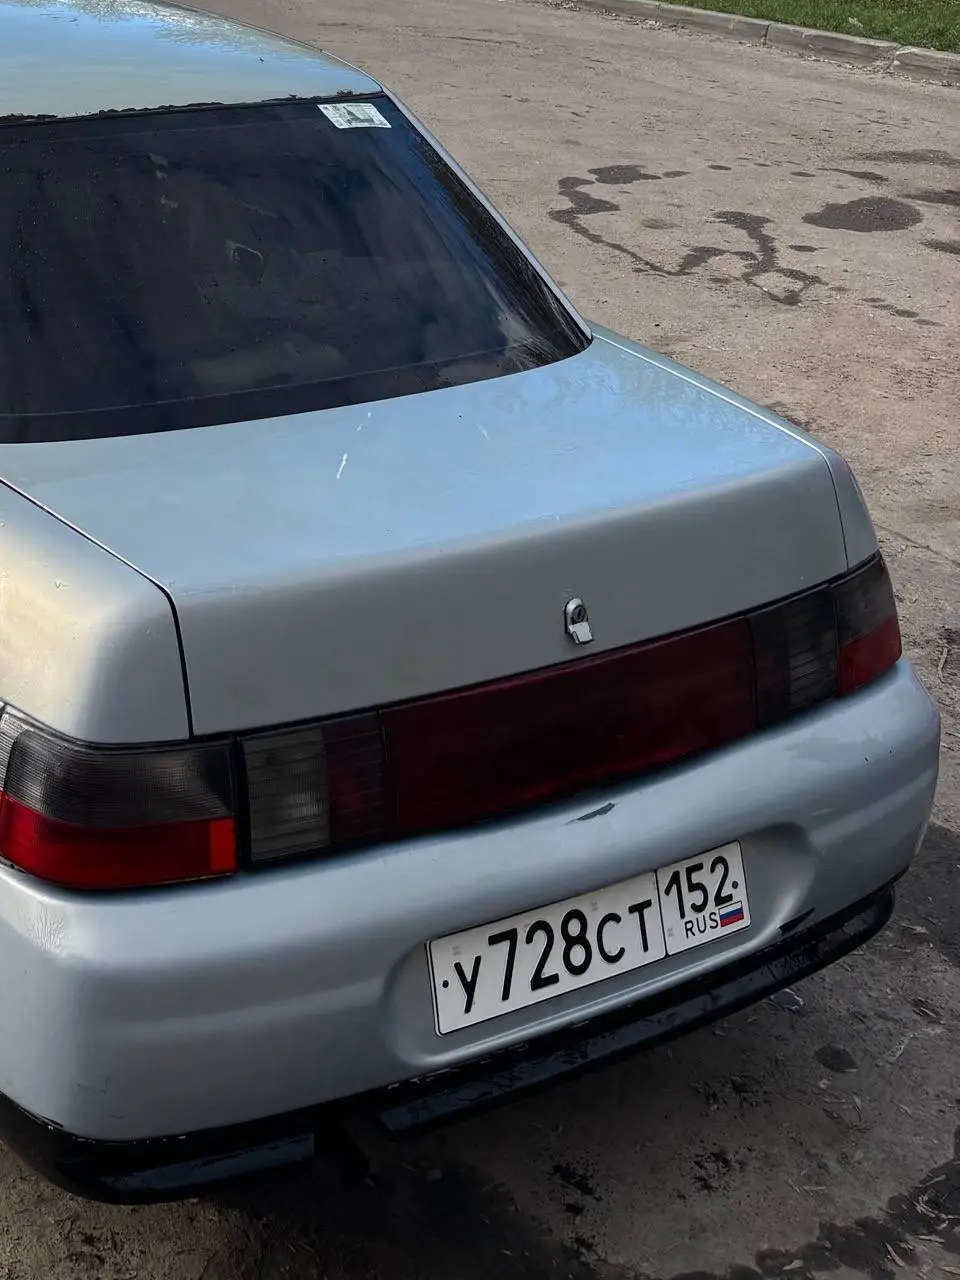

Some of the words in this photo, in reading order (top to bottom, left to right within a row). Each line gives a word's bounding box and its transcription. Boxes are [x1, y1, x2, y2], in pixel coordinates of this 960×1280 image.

[453, 899, 652, 1014] У728СТ
[663, 855, 734, 920] 152
[684, 912, 719, 939] RUS
